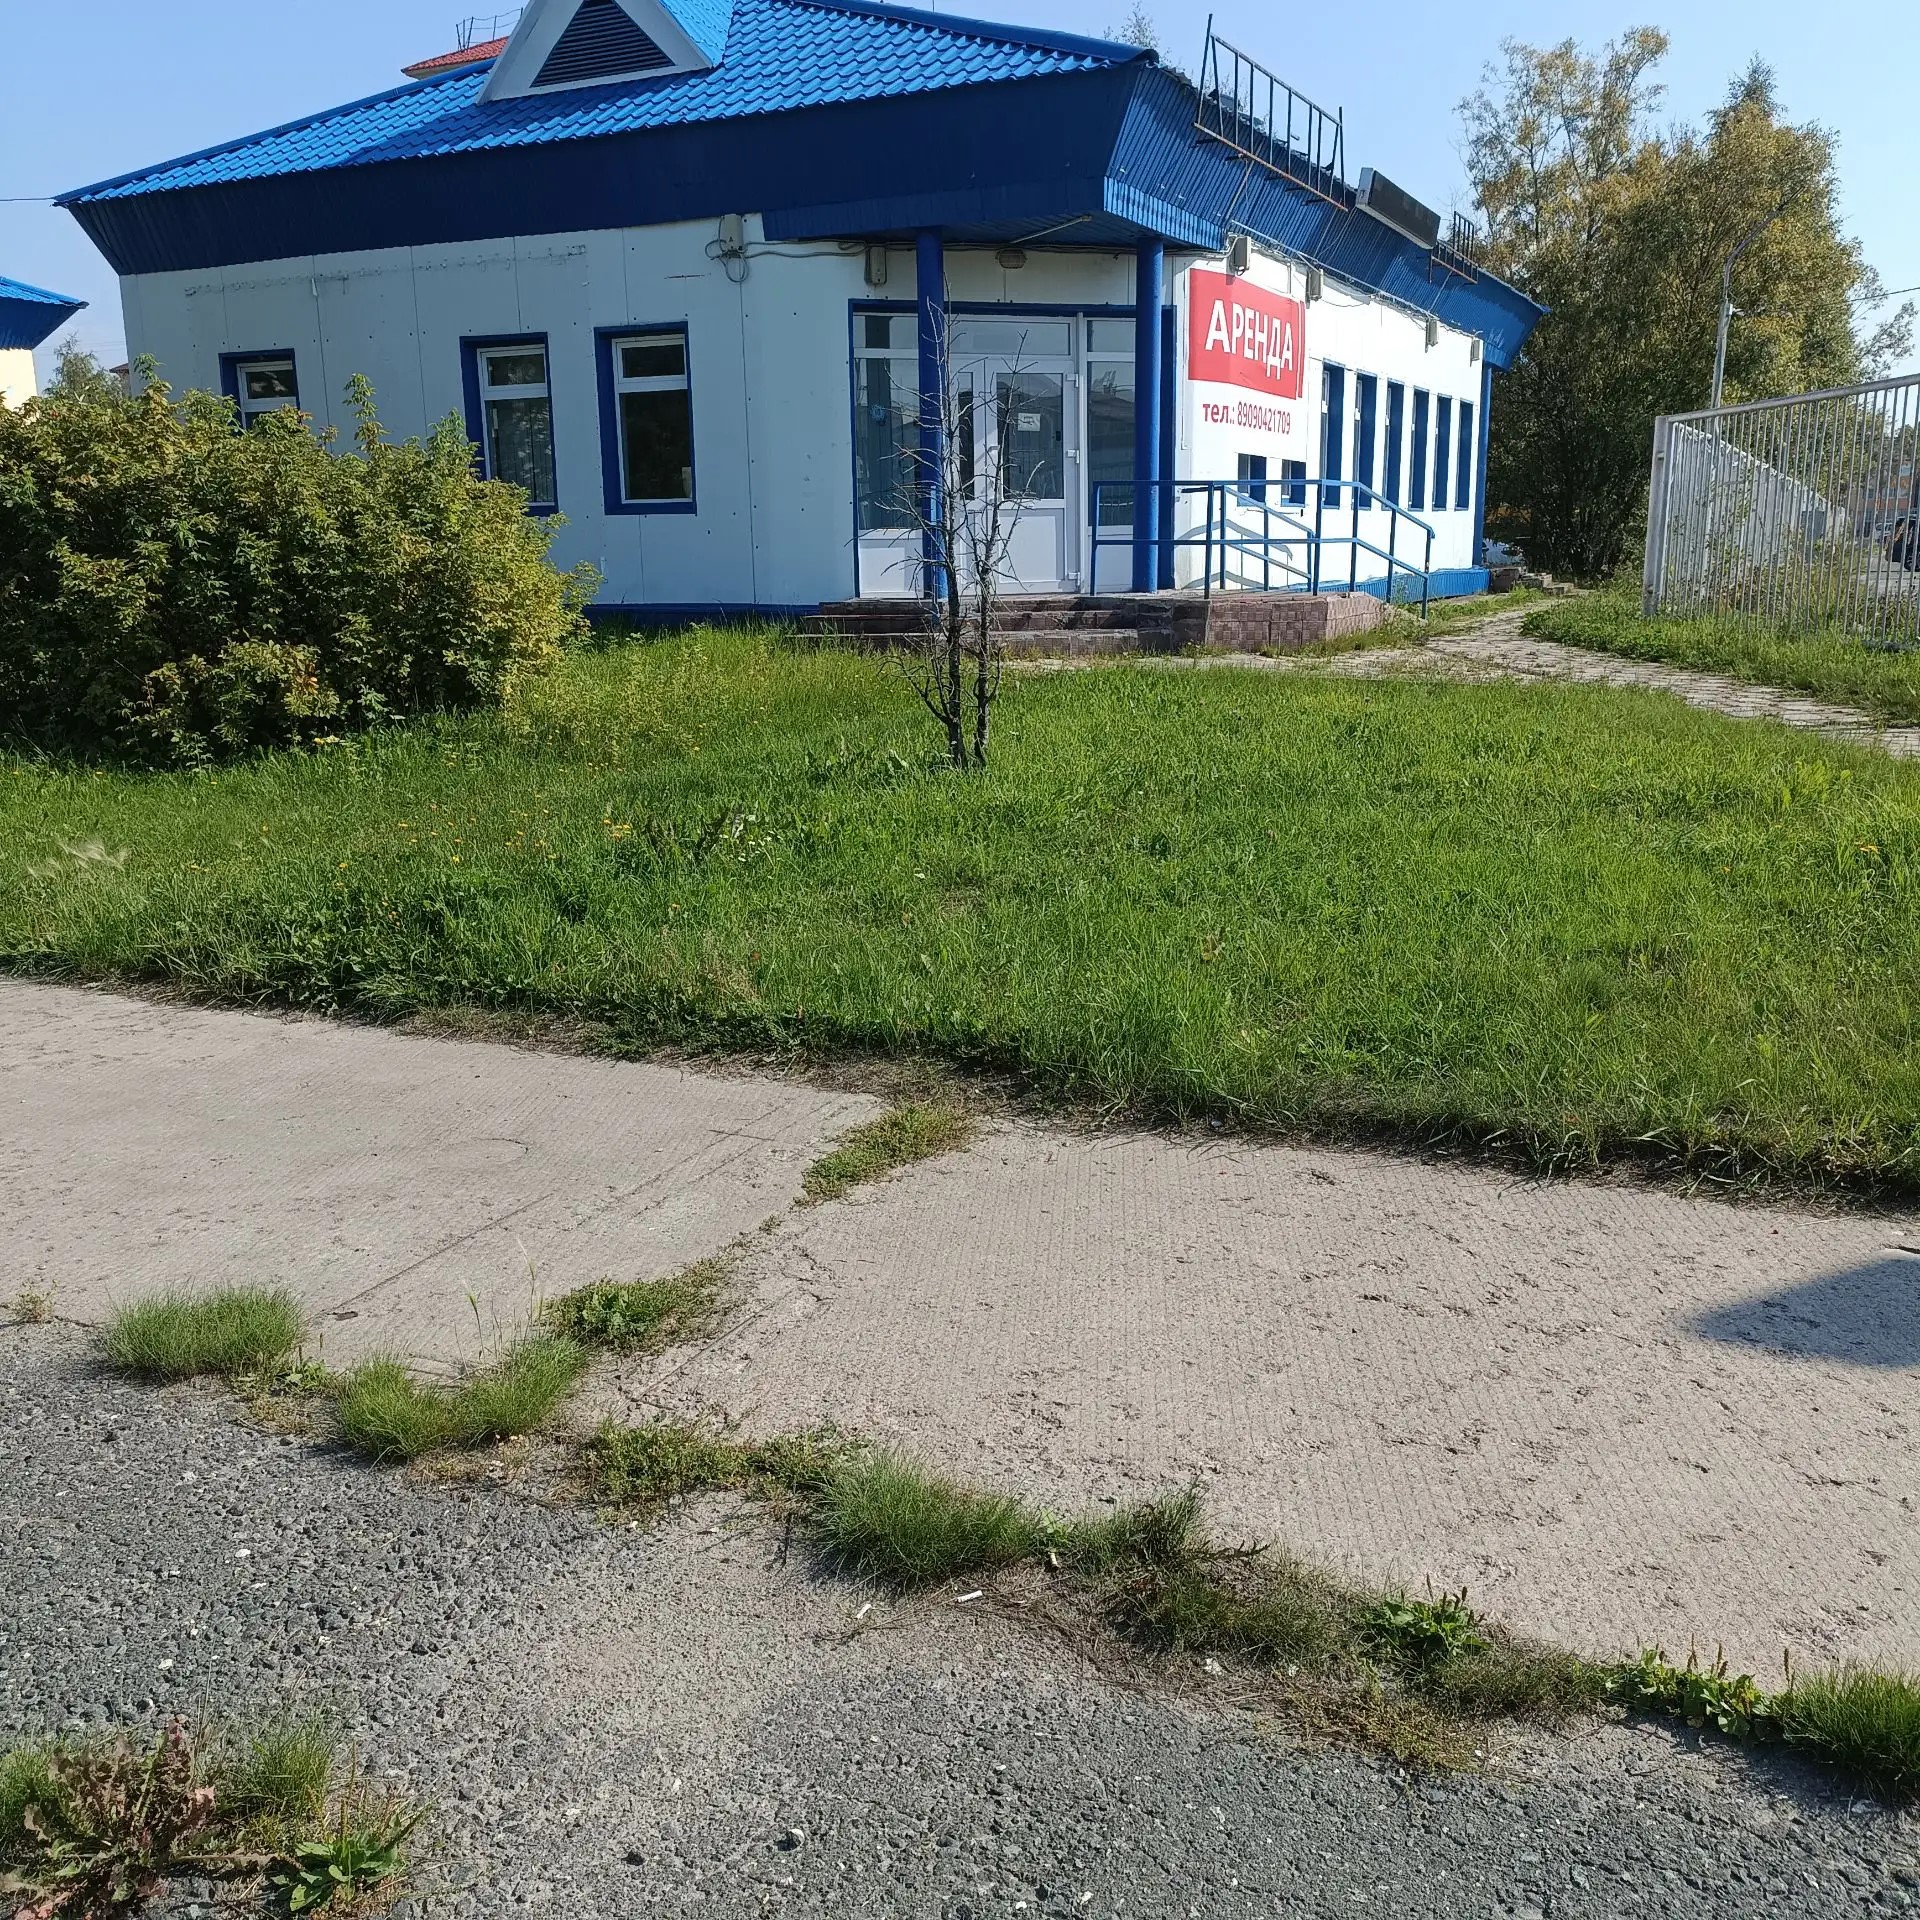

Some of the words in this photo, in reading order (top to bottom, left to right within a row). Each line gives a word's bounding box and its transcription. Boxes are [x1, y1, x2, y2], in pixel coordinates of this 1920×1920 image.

[1205, 299, 1293, 380] АРЕНДА
[1203, 404, 1234, 424] тел.:
[1237, 401, 1291, 435] 89090421709
